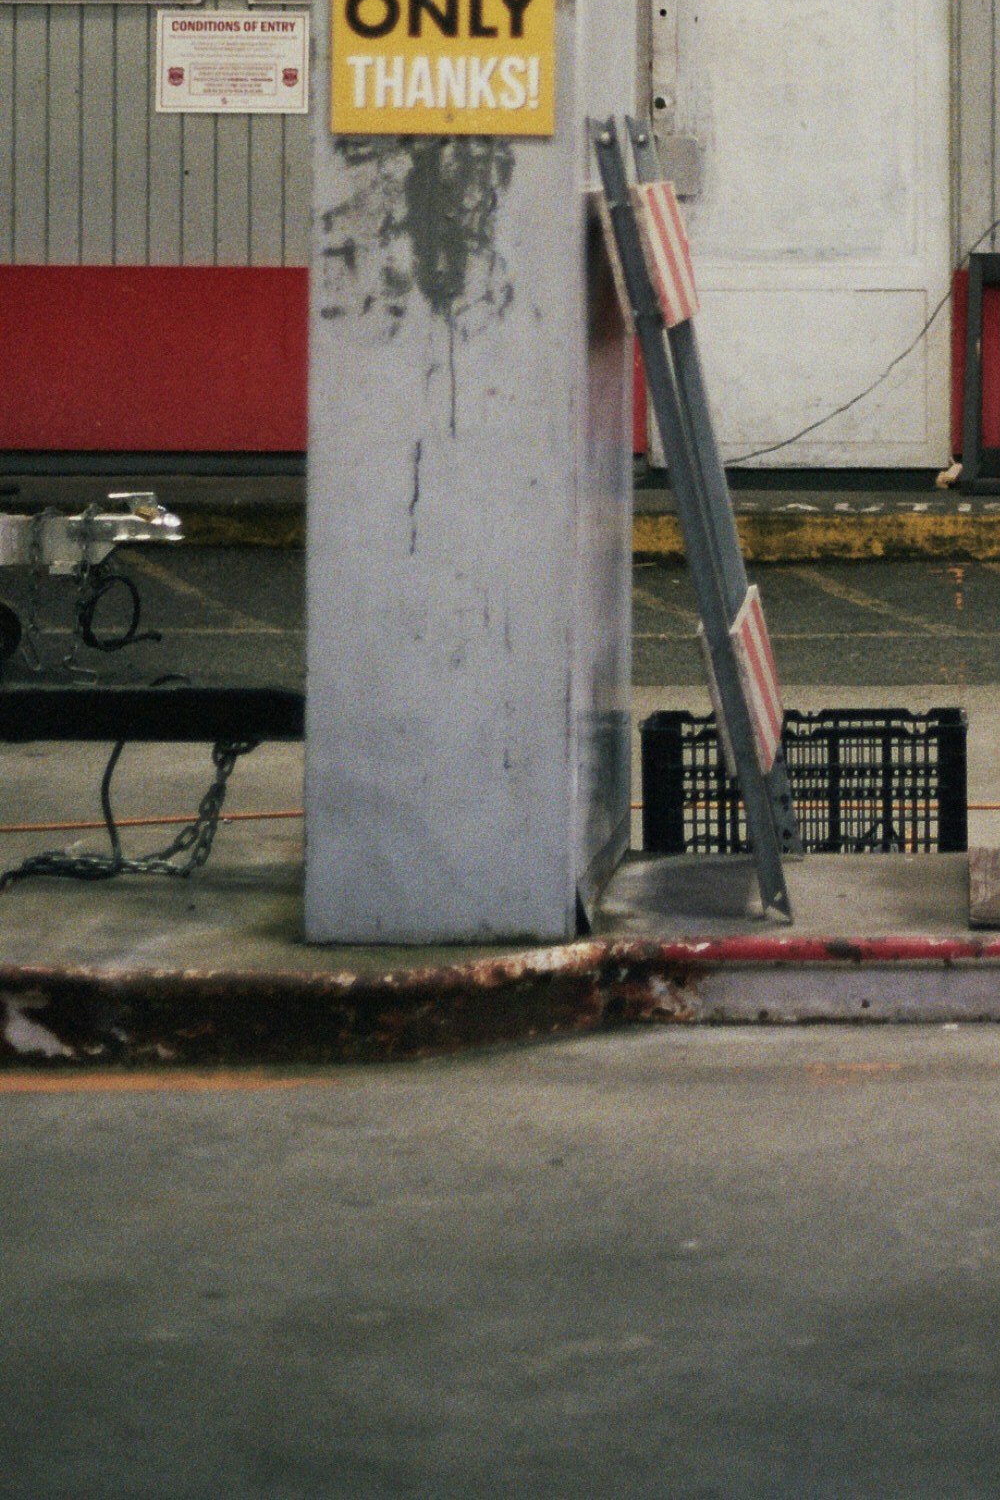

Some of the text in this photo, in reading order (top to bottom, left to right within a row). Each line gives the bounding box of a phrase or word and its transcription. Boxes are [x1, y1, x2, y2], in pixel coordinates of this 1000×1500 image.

[171, 20, 296, 32] CONDITIONS OF ENTRY
[346, 55, 540, 110] THANKS!
